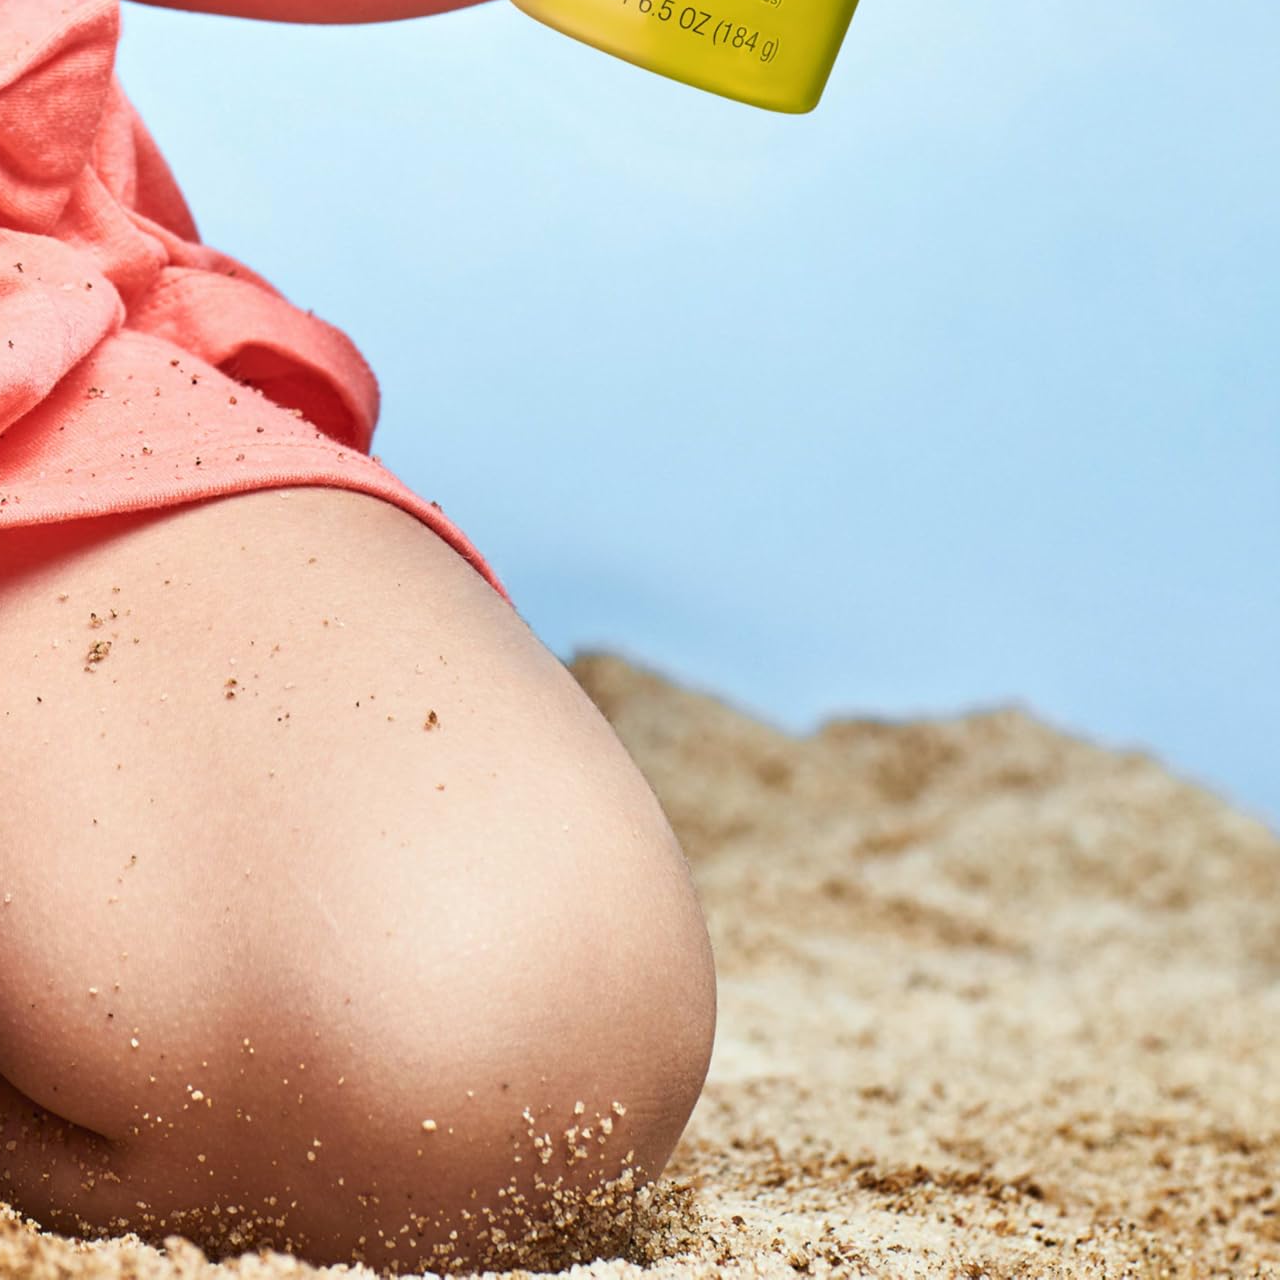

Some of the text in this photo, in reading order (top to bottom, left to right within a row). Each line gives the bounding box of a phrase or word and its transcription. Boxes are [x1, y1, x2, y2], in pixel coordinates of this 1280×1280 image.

[679, 7, 712, 37] OZ
[713, 20, 759, 52] (184
[760, 38, 780, 63] g)
